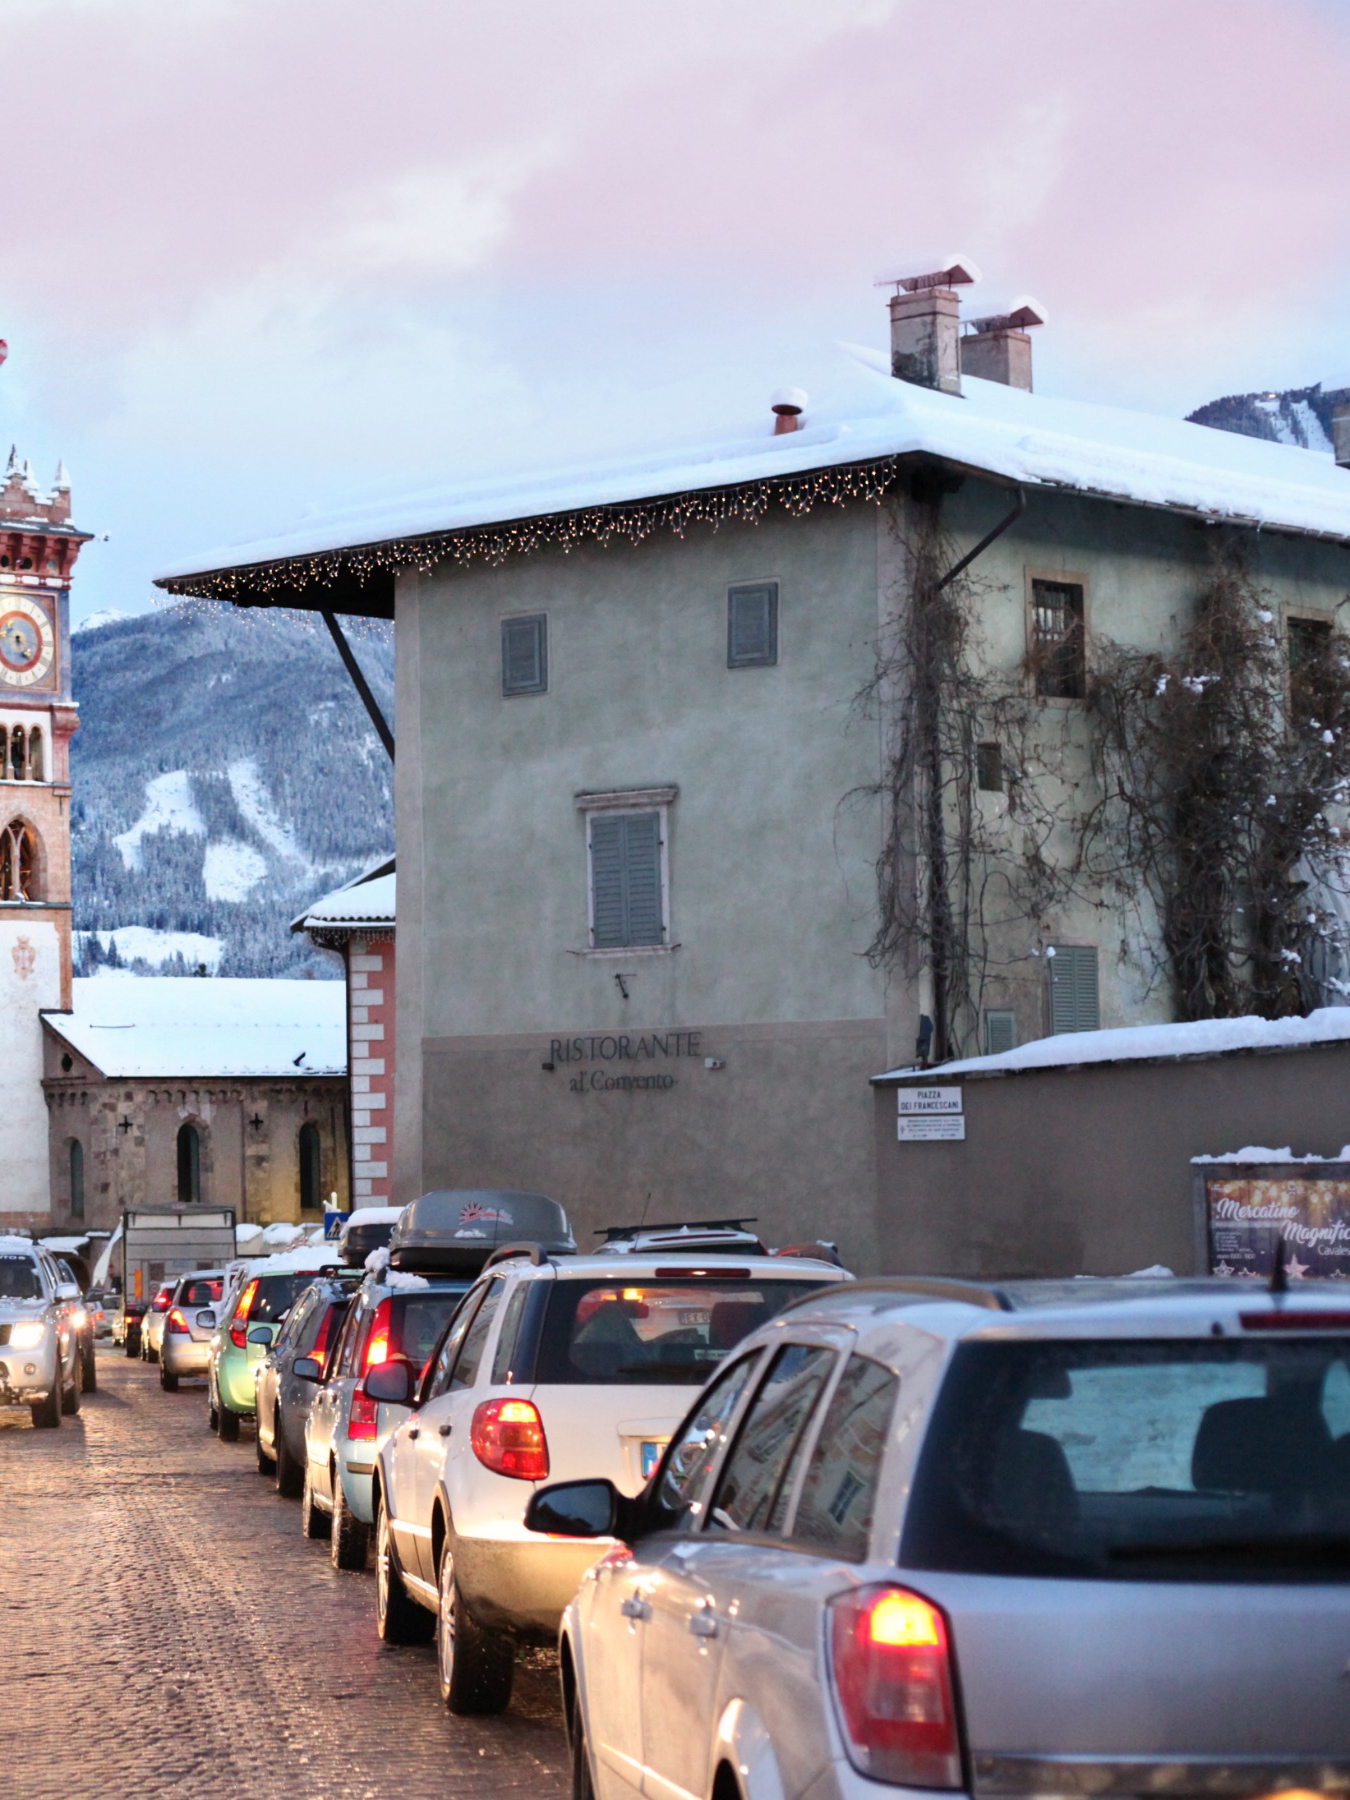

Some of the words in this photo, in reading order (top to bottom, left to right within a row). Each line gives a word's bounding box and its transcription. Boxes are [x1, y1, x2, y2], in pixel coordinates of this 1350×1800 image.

[550, 1031, 702, 1063] RISTORANTE
[590, 1069, 675, 1092] Convento
[901, 1102, 912, 1110] DEI
[913, 1101, 959, 1110] FRANCESCANI
[917, 1091, 941, 1099] PIAZZA
[1216, 1197, 1300, 1222] Mercatino
